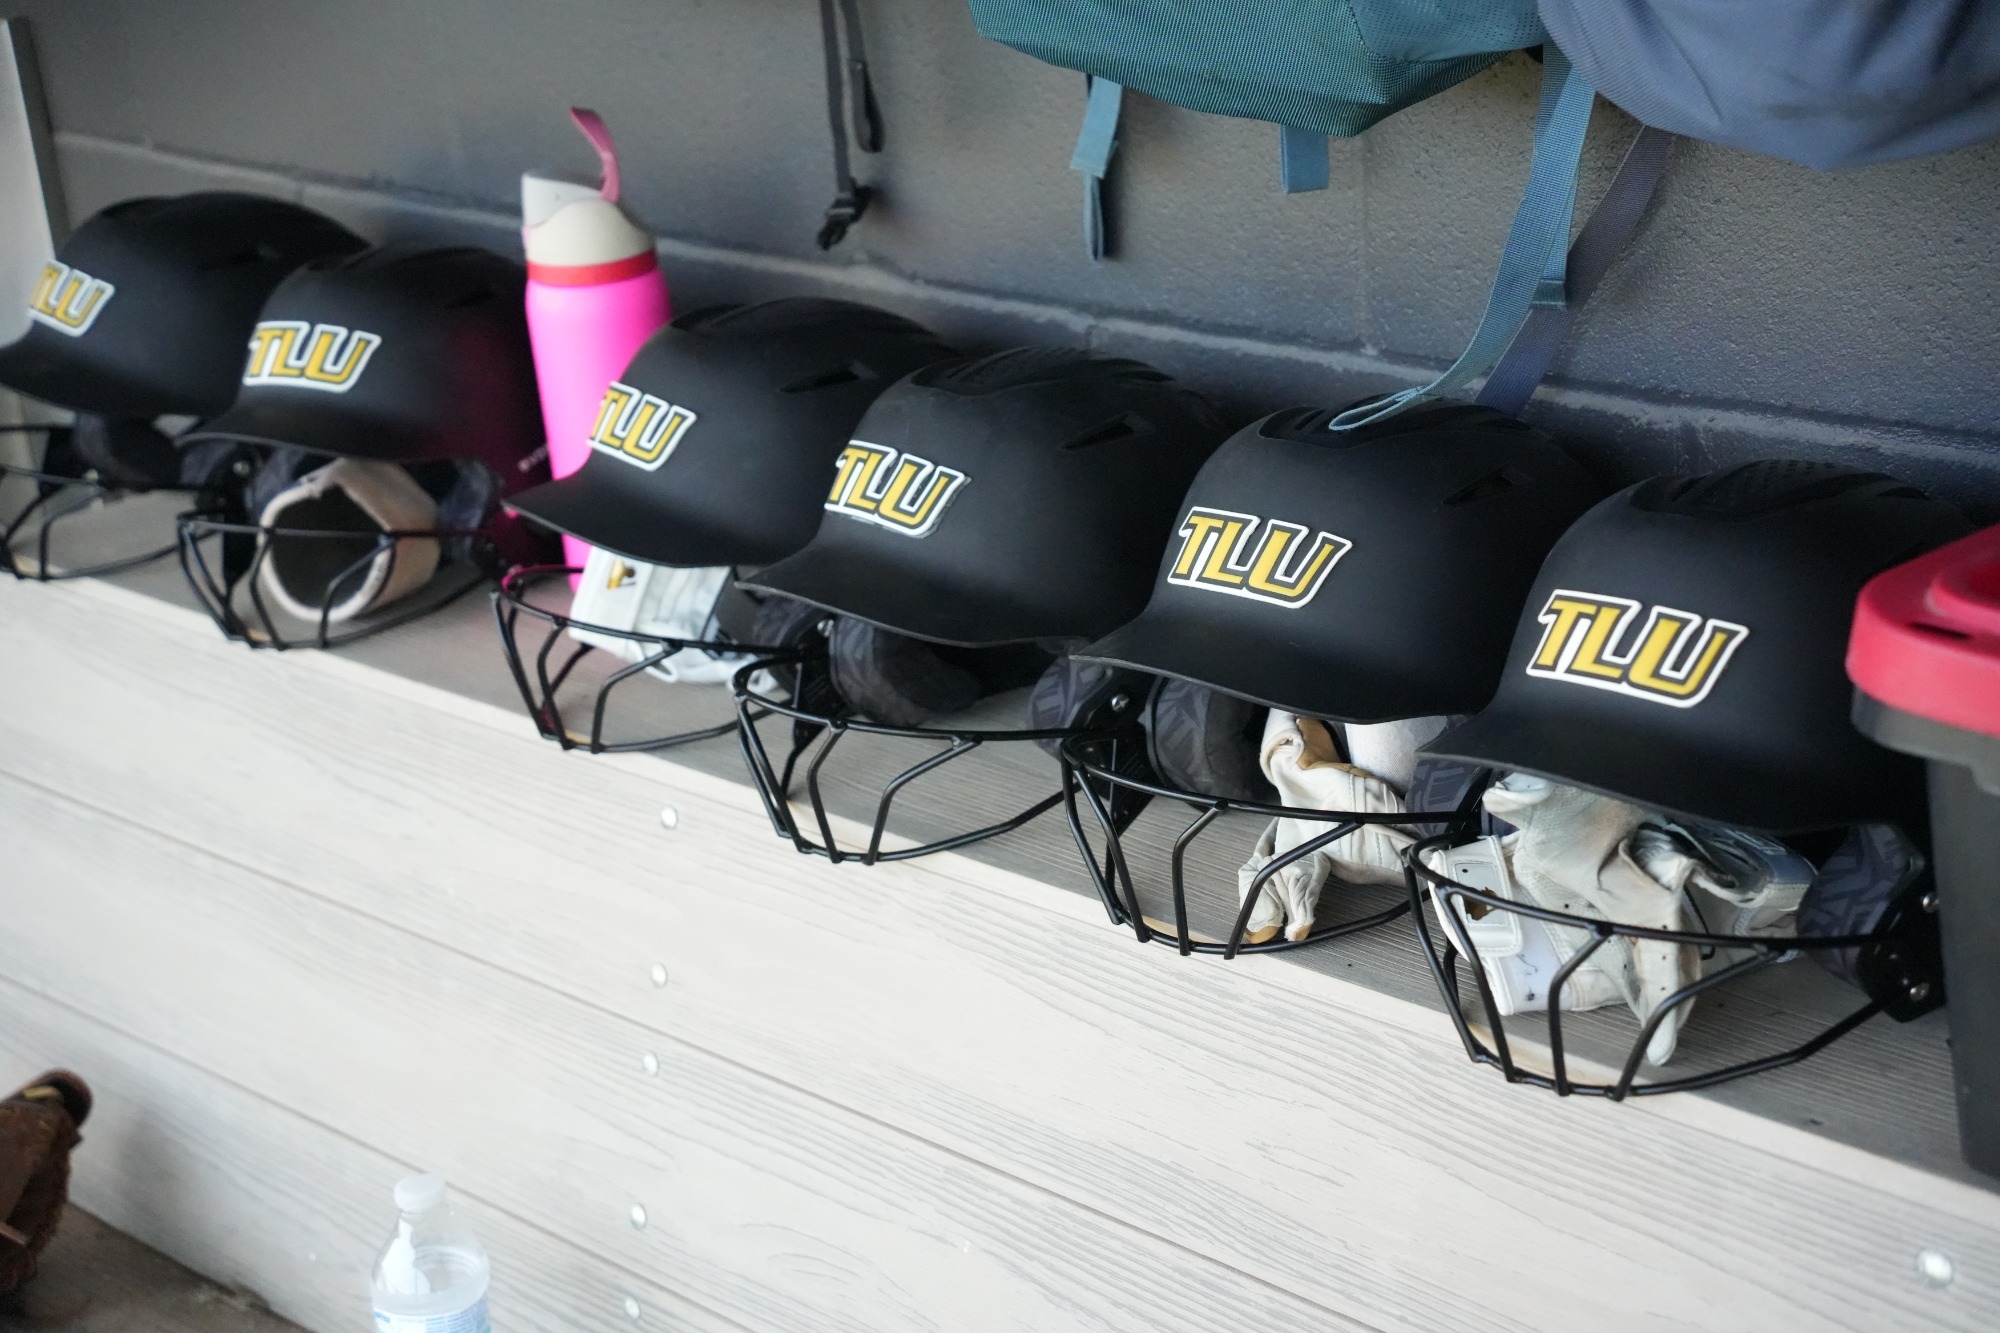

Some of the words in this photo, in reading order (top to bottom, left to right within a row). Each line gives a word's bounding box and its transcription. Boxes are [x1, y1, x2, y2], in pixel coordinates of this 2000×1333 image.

[245, 323, 377, 389] TLU
[825, 442, 960, 532] TLU
[1169, 509, 1348, 605] TLU
[1529, 592, 1743, 704] TLU
